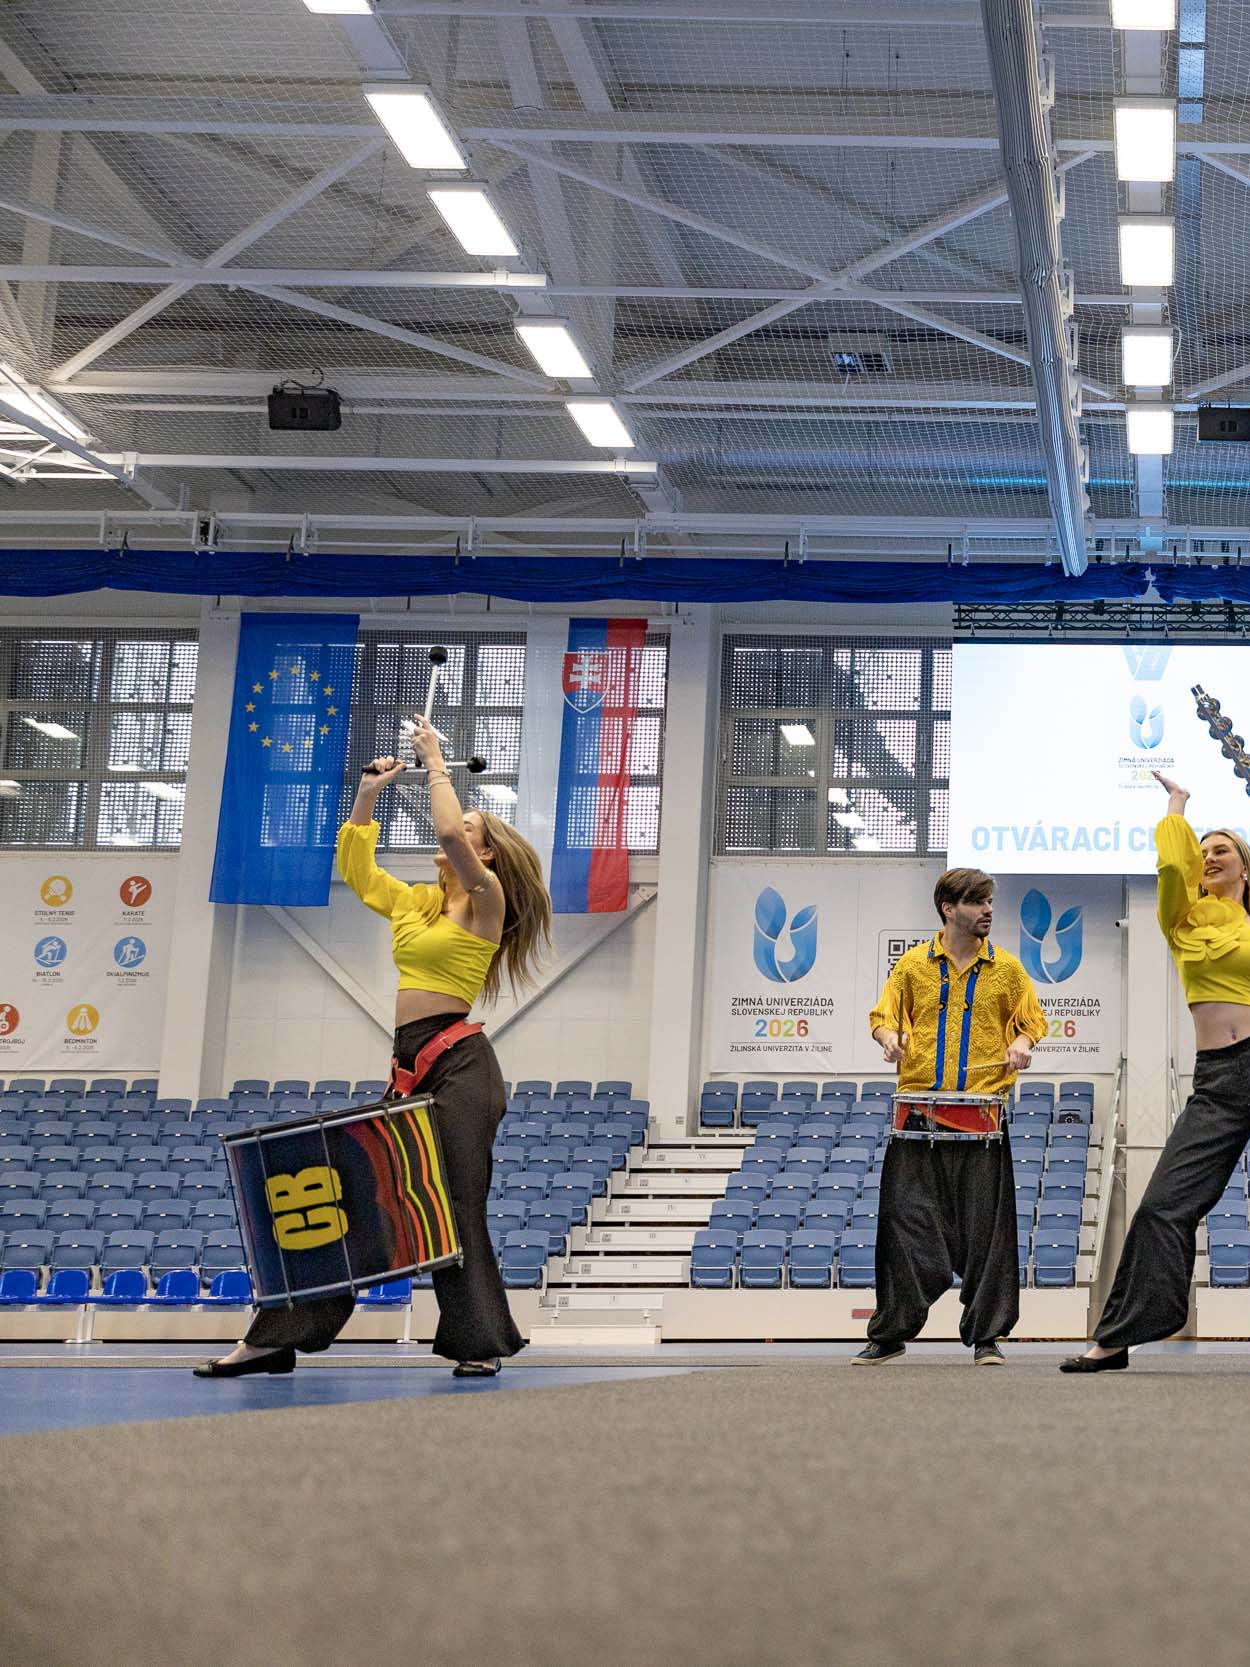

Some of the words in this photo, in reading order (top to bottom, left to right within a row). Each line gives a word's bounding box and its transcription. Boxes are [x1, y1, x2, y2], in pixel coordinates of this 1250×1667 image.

[970, 820, 1121, 852] OTVÁRACÍ
[731, 996, 763, 1007] ZIMNÁ
[766, 996, 834, 1007] UNIVERZIÁDA
[1038, 996, 1101, 1008] NIVERZIÁDA
[731, 1008, 786, 1016] SLOVENSKEJ
[787, 1008, 834, 1016] REPUBLIKY
[1054, 1009, 1101, 1017] REPUBLIKY
[754, 1019, 809, 1038] 2026
[1050, 1019, 1076, 1038] 26
[763, 1045, 803, 1053] UNIVERZITA
[1078, 1045, 1101, 1053] ŽILINE
